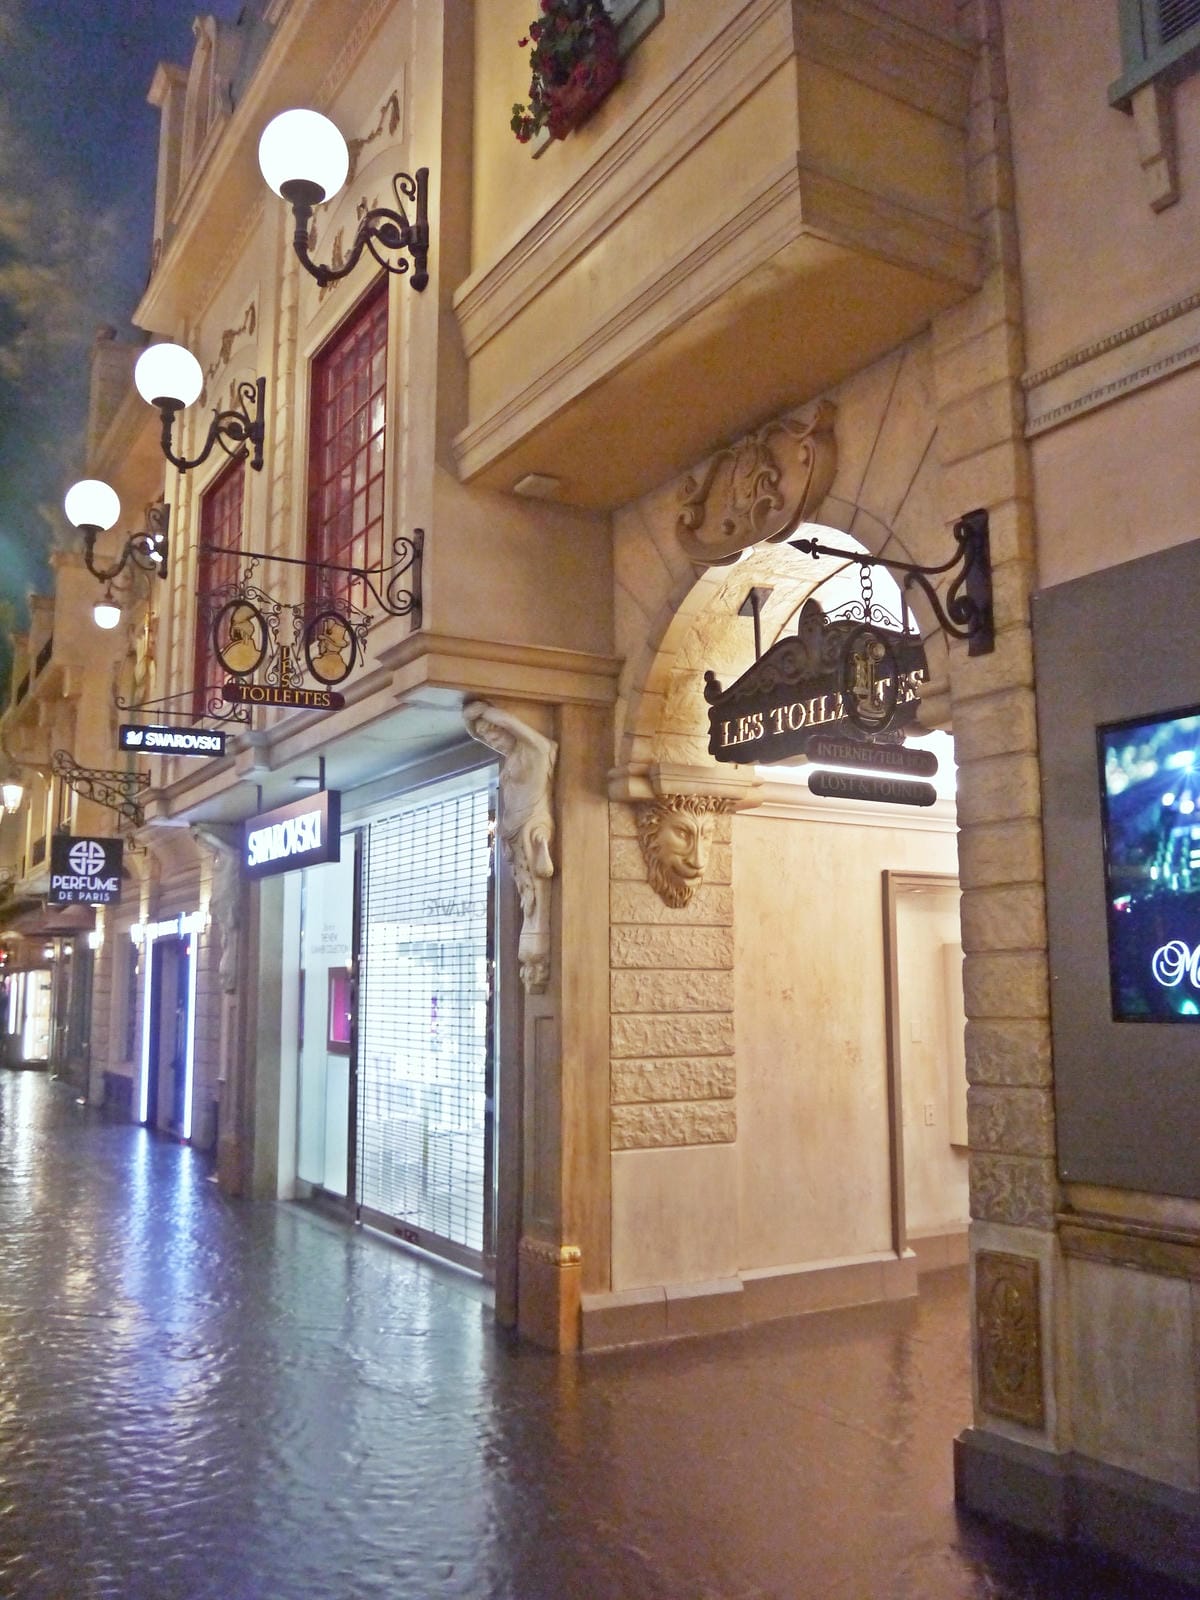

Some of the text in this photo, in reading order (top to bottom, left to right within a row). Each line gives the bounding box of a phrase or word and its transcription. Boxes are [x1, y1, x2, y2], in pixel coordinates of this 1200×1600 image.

[281, 648, 290, 686] LES
[240, 686, 331, 706] TOILETTES
[721, 712, 764, 746] LES
[145, 732, 221, 750] SWAROVSKI
[820, 774, 924, 799] LOST & FOUND
[248, 810, 322, 866] SWAROVSKI
[52, 875, 119, 891] PERFUME
[58, 891, 110, 902] DE PARIS
